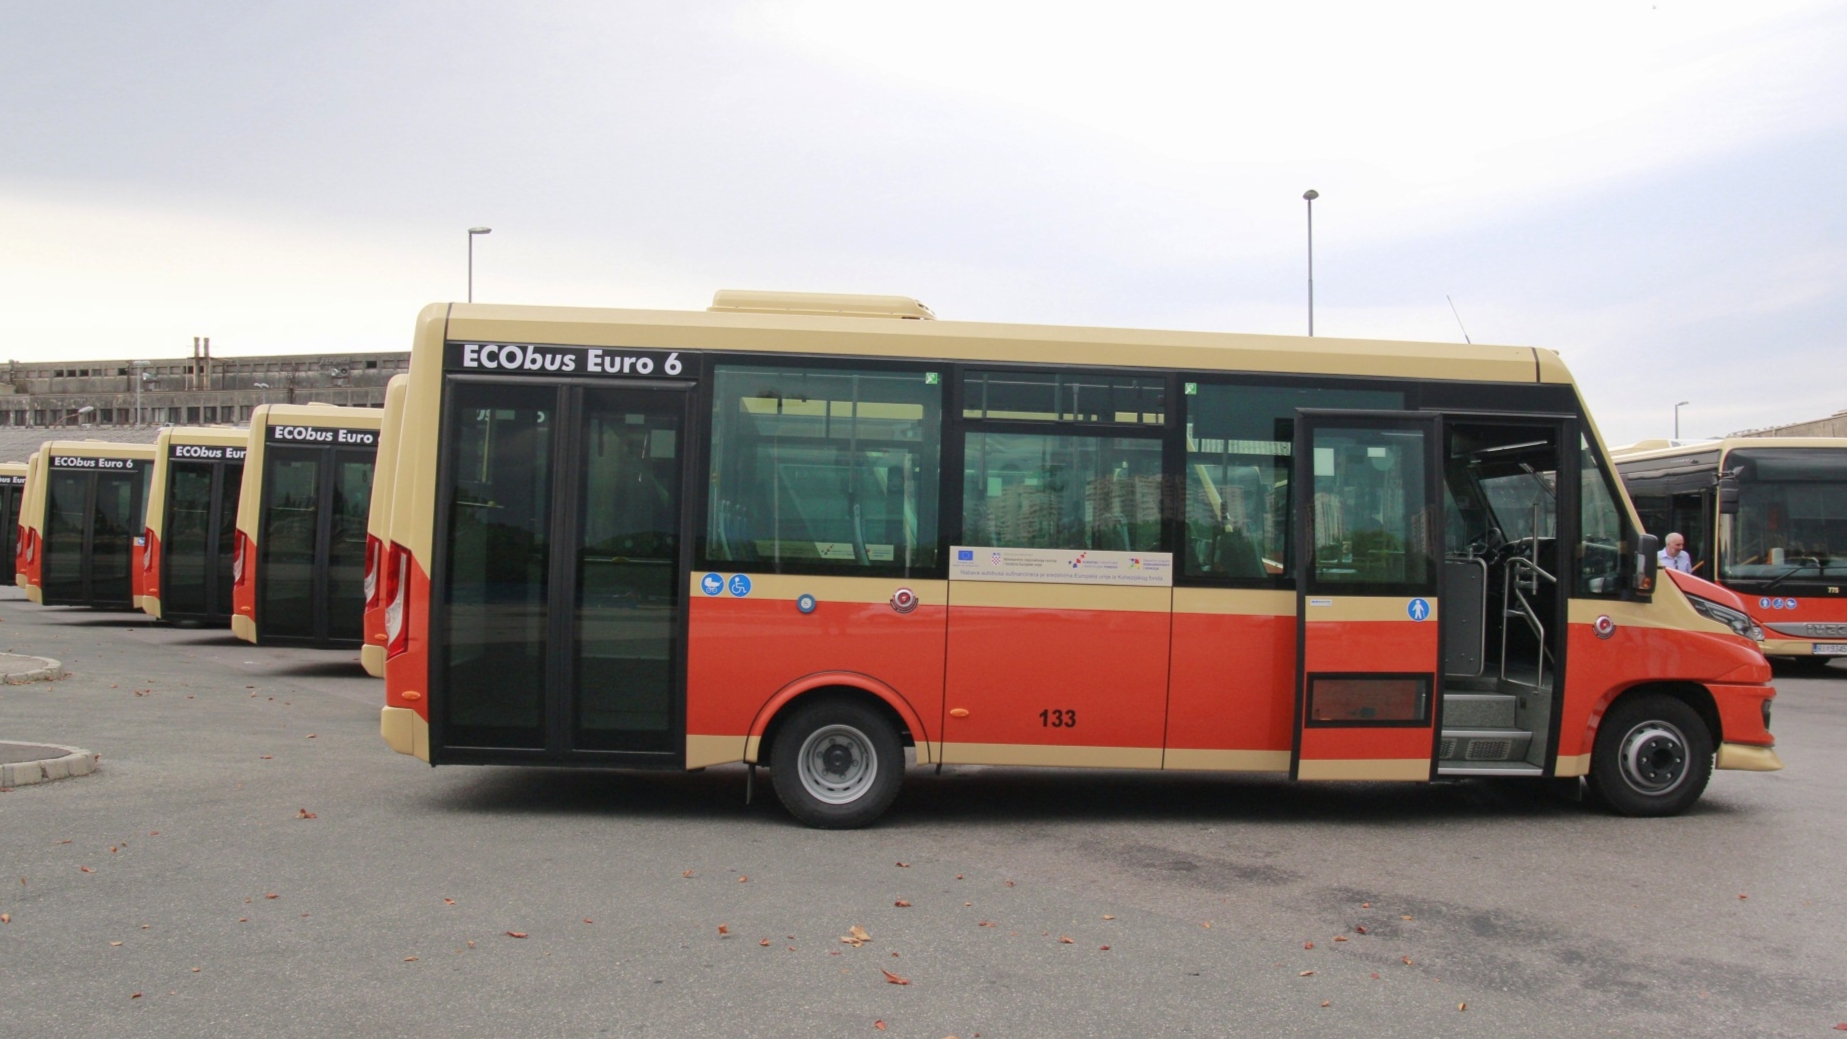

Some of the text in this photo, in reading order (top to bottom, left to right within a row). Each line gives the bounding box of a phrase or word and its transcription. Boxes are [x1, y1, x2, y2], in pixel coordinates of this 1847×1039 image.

[463, 344, 682, 376] ECObus Euro 6
[274, 426, 333, 442] ECObus
[338, 429, 374, 444] Euro
[175, 446, 247, 458] ECObus Eur
[54, 457, 133, 469] ECObus Euro 6
[12, 476, 26, 484] Eur
[1827, 586, 1839, 594] 775
[1806, 624, 1847, 636] IVEC
[1039, 709, 1077, 728] 133
